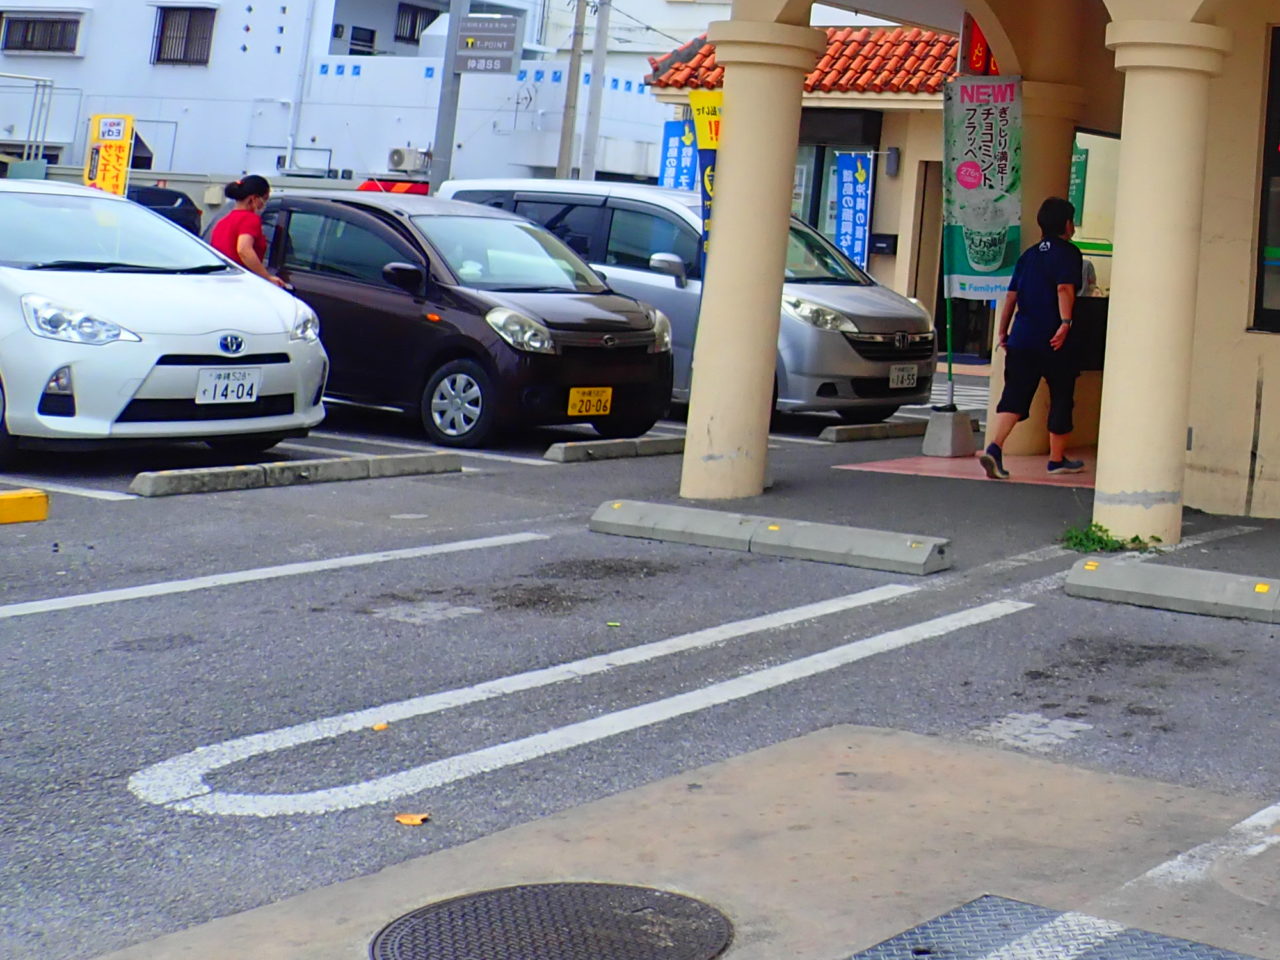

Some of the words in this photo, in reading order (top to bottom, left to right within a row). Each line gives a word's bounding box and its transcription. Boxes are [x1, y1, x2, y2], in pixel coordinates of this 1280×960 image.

[960, 83, 1016, 105] NEW!
[964, 107, 978, 159] フラッペ
[981, 107, 995, 188] チョコミント
[996, 106, 1010, 190] ぎっしり満足！
[969, 283, 1009, 294] FamilyMa
[212, 383, 254, 400] 14-04
[578, 399, 609, 413] 20-06
